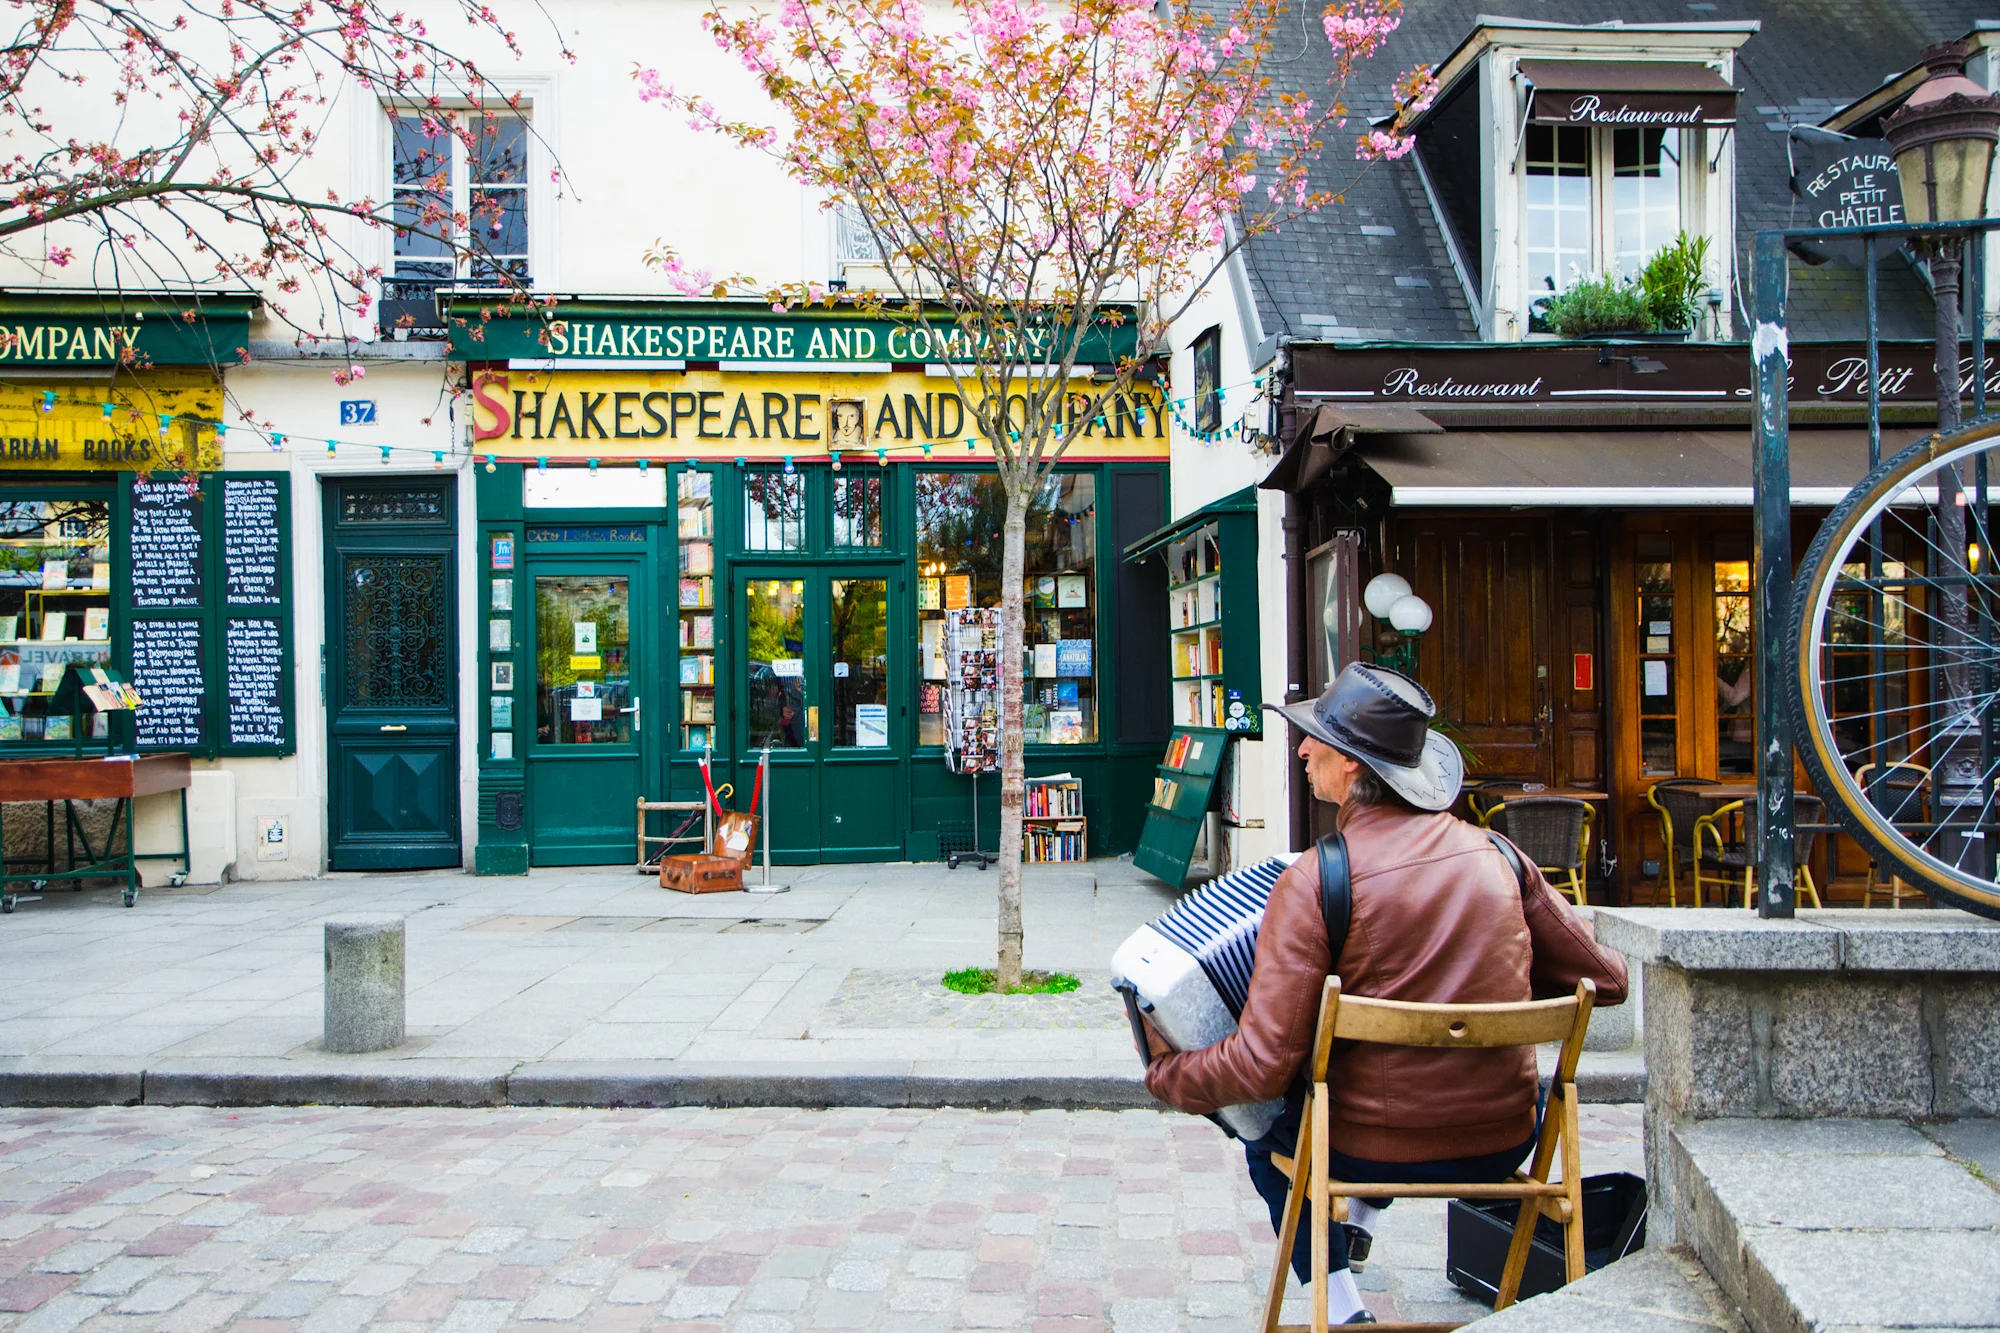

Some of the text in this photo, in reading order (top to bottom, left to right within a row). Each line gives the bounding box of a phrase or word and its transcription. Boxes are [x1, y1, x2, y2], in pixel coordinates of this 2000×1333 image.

[1569, 95, 1702, 123] Restaurant
[1853, 174, 1876, 189] LE
[546, 320, 795, 358] SHAKESPEARE
[807, 328, 876, 359] AND
[1381, 367, 1544, 396] Restaurant
[345, 403, 372, 423] 37
[472, 374, 821, 443] SHAKESPEARE
[873, 392, 965, 440] AND
[84, 439, 151, 461] BOOKS
